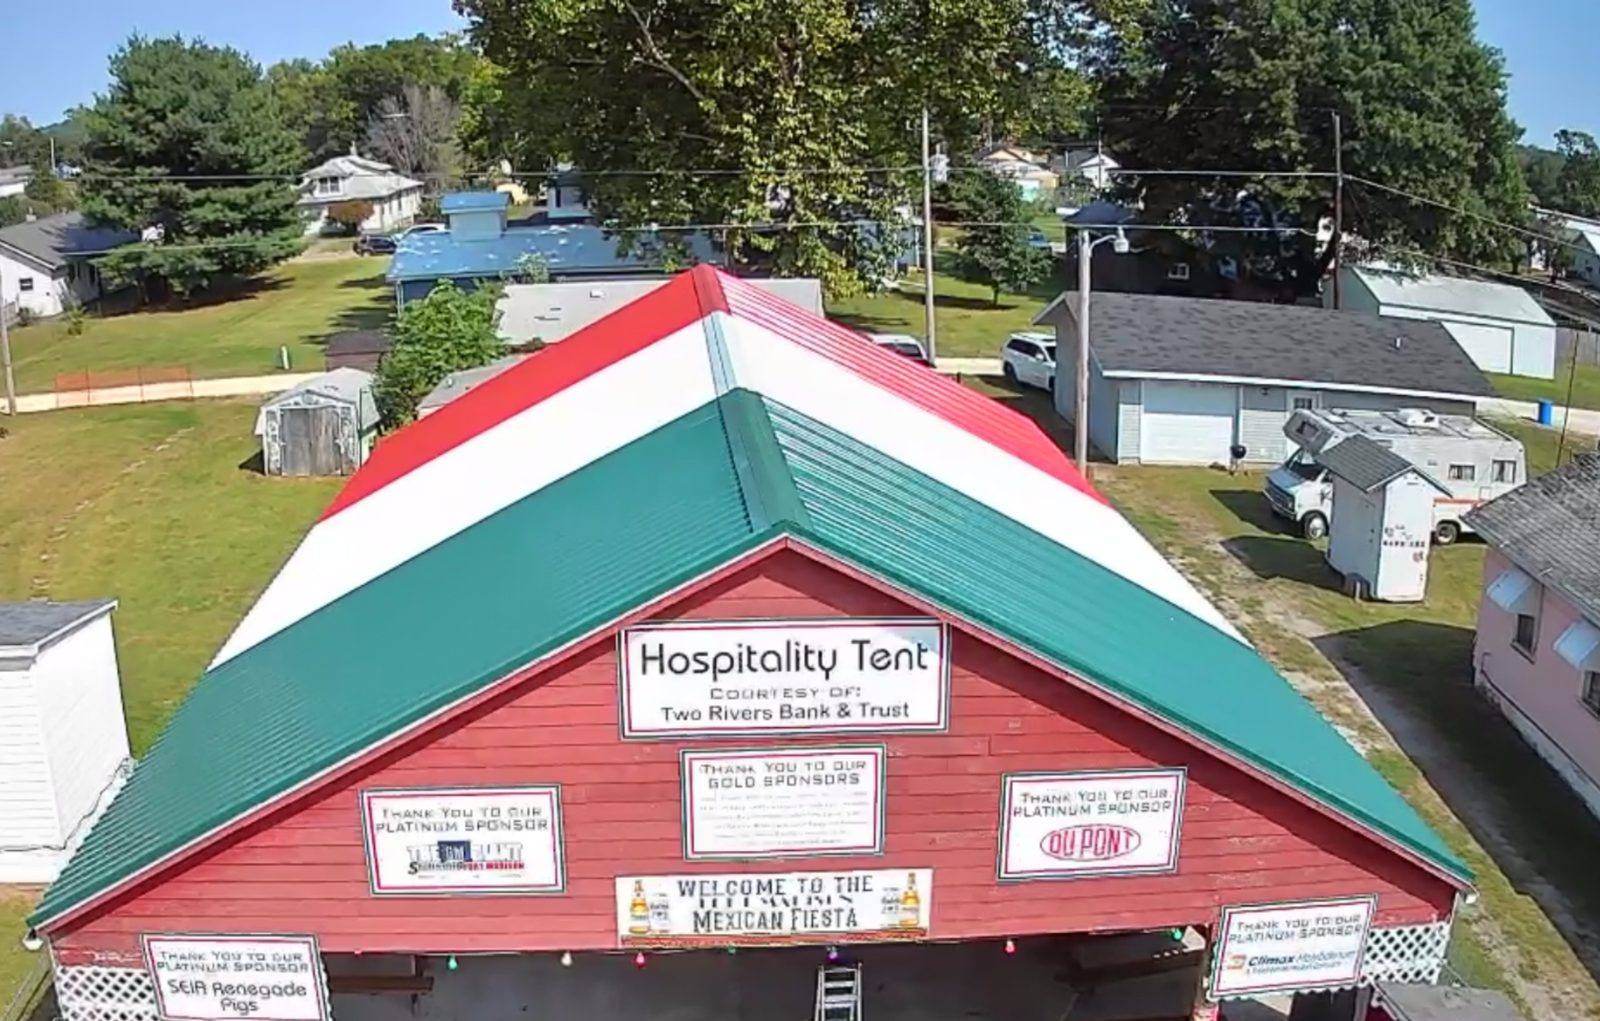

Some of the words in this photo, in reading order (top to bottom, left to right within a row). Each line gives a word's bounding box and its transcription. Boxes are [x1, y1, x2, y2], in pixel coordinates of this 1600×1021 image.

[641, 640, 838, 682] Hospitality
[851, 639, 929, 671] Tent
[709, 687, 821, 700] COURTESY
[829, 686, 862, 698] OF:
[661, 706, 702, 722] Two
[708, 704, 773, 721] Rivers
[779, 702, 831, 720] Bank
[837, 703, 851, 718] &
[858, 701, 910, 718] Trust
[701, 763, 756, 775] THANK
[764, 762, 798, 773] YOU
[806, 761, 826, 772] TO
[833, 760, 867, 771] OUR
[708, 775, 756, 789] GOLD
[764, 772, 861, 787] SPONSORS
[1021, 792, 1072, 804] THANK
[1078, 791, 1108, 802] YOU
[1114, 790, 1133, 800] TO
[1138, 788, 1168, 799] OUR
[382, 807, 435, 819] THANK
[442, 806, 474, 818] YOU
[481, 806, 501, 817] TO
[507, 806, 542, 817] OUR
[1013, 805, 1092, 818] PLATINUM
[1097, 801, 1172, 815] SPONSOR
[376, 821, 459, 833] PLATINUM
[464, 819, 549, 832] SPONSOR
[1081, 827, 1134, 858] PONT
[678, 877, 787, 897] WELCOME
[800, 877, 823, 894] TO
[835, 875, 874, 892] THE
[693, 910, 784, 933] MEXICAN
[791, 907, 859, 931] FIESTA
[1238, 921, 1282, 931] THANK
[1285, 919, 1310, 929] YOU
[1316, 916, 1331, 926] TO
[1335, 914, 1361, 925] OUR
[1229, 931, 1296, 944] PLATINUM
[1299, 924, 1362, 939] SPONSOR
[160, 951, 207, 961] THANK
[211, 951, 242, 961] YOU
[247, 952, 266, 961] TO
[272, 952, 303, 962] OUR
[1248, 955, 1295, 967] Climax
[157, 962, 229, 973] PLATINUM
[233, 962, 309, 974] SPONSOR
[212, 981, 307, 999] Renegade
[220, 998, 259, 1015] Pigs
